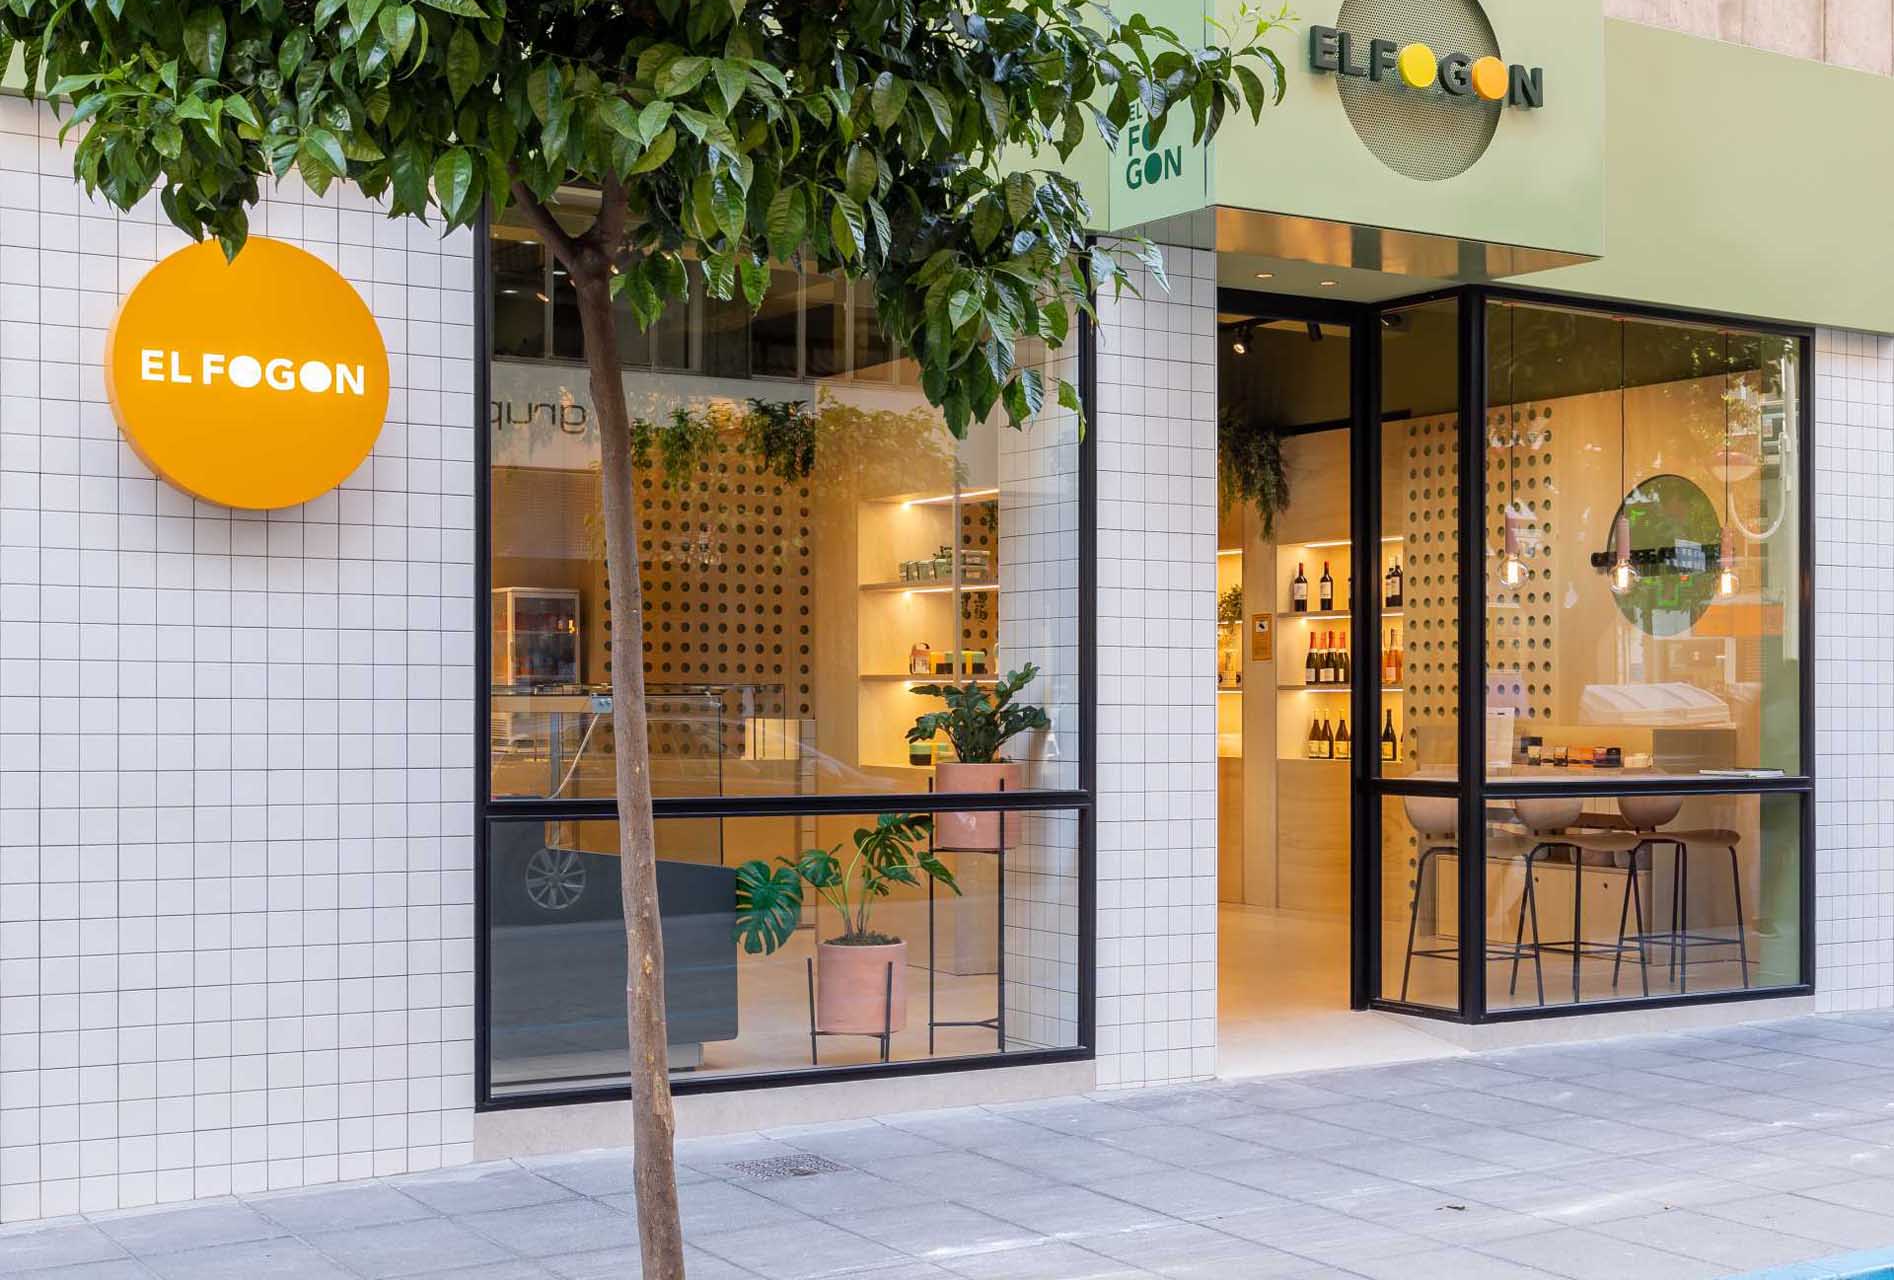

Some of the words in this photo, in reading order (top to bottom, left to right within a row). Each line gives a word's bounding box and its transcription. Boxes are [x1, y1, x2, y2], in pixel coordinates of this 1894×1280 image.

[1310, 25, 1367, 77] EL
[1370, 38, 1543, 108] FOGON
[1126, 145, 1182, 190] GON
[141, 349, 192, 384] EL
[202, 353, 365, 396] FOGON
